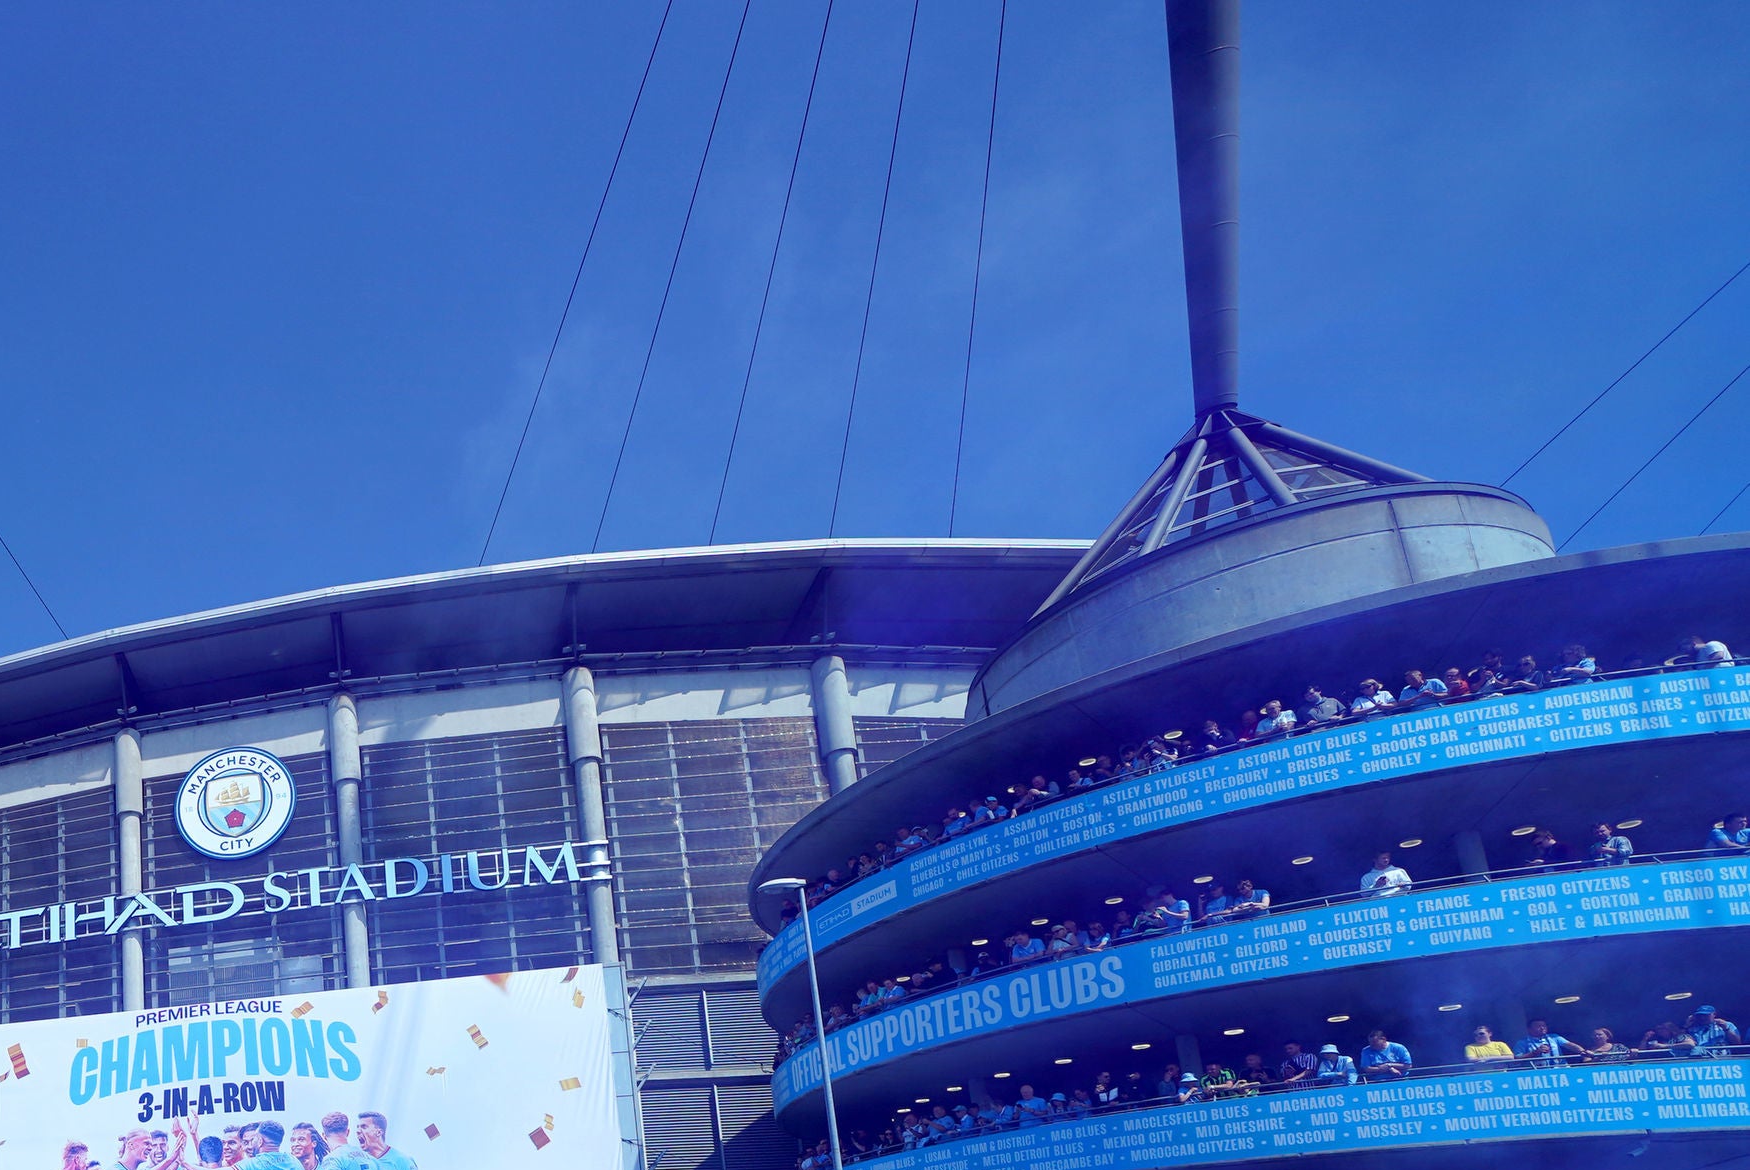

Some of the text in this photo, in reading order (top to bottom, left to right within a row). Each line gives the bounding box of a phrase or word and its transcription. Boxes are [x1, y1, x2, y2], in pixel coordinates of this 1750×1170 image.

[1288, 698, 1682, 773] BRISBANE BROOKS BUCHAREST BUENOS AIRES
[1326, 677, 1710, 749] BLUES ATLANTA CITYZENS AUDENSHAW AUSTIN
[1362, 716, 1672, 774] CHORLEY CINCINNATI CITIZENS BRASIL
[188, 755, 281, 795] MANCHESTER
[220, 837, 254, 851] CITY
[263, 841, 581, 914] STADIUM
[1151, 868, 1714, 959] FALLOWFIELD FINLAND FLIXTON FRANCE FRESNO CITYZENS FRISCO
[1153, 886, 1714, 973] GIBRALTAR GLOUCESTER CHELTENHAM GOA GORTON GRAND
[1154, 906, 1690, 988] GUATEMALA CITYZENS GUERNSEY GUIYANG HALE ALTRINGHAM
[136, 1000, 282, 1028] PREMIER LEAGUE
[847, 956, 1125, 1066] SUPPORTERS CLUBS
[69, 1017, 361, 1106] CHAMPIONS
[138, 1080, 285, 1123] 3-IN-A-ROW
[1123, 1064, 1743, 1132] MACCLESFIELD MACHAKOS MALLORCA BLUES MALTA MANIPUR CITYZENS
[1224, 1083, 1746, 1136] CHESHIRE SUSSEX BLUES MIDDLETON MILANO BLUE MOON
[1130, 1115, 1498, 1162] MOROCCAN CITYZENS MOSCOW MOSSLEY MOUNT
